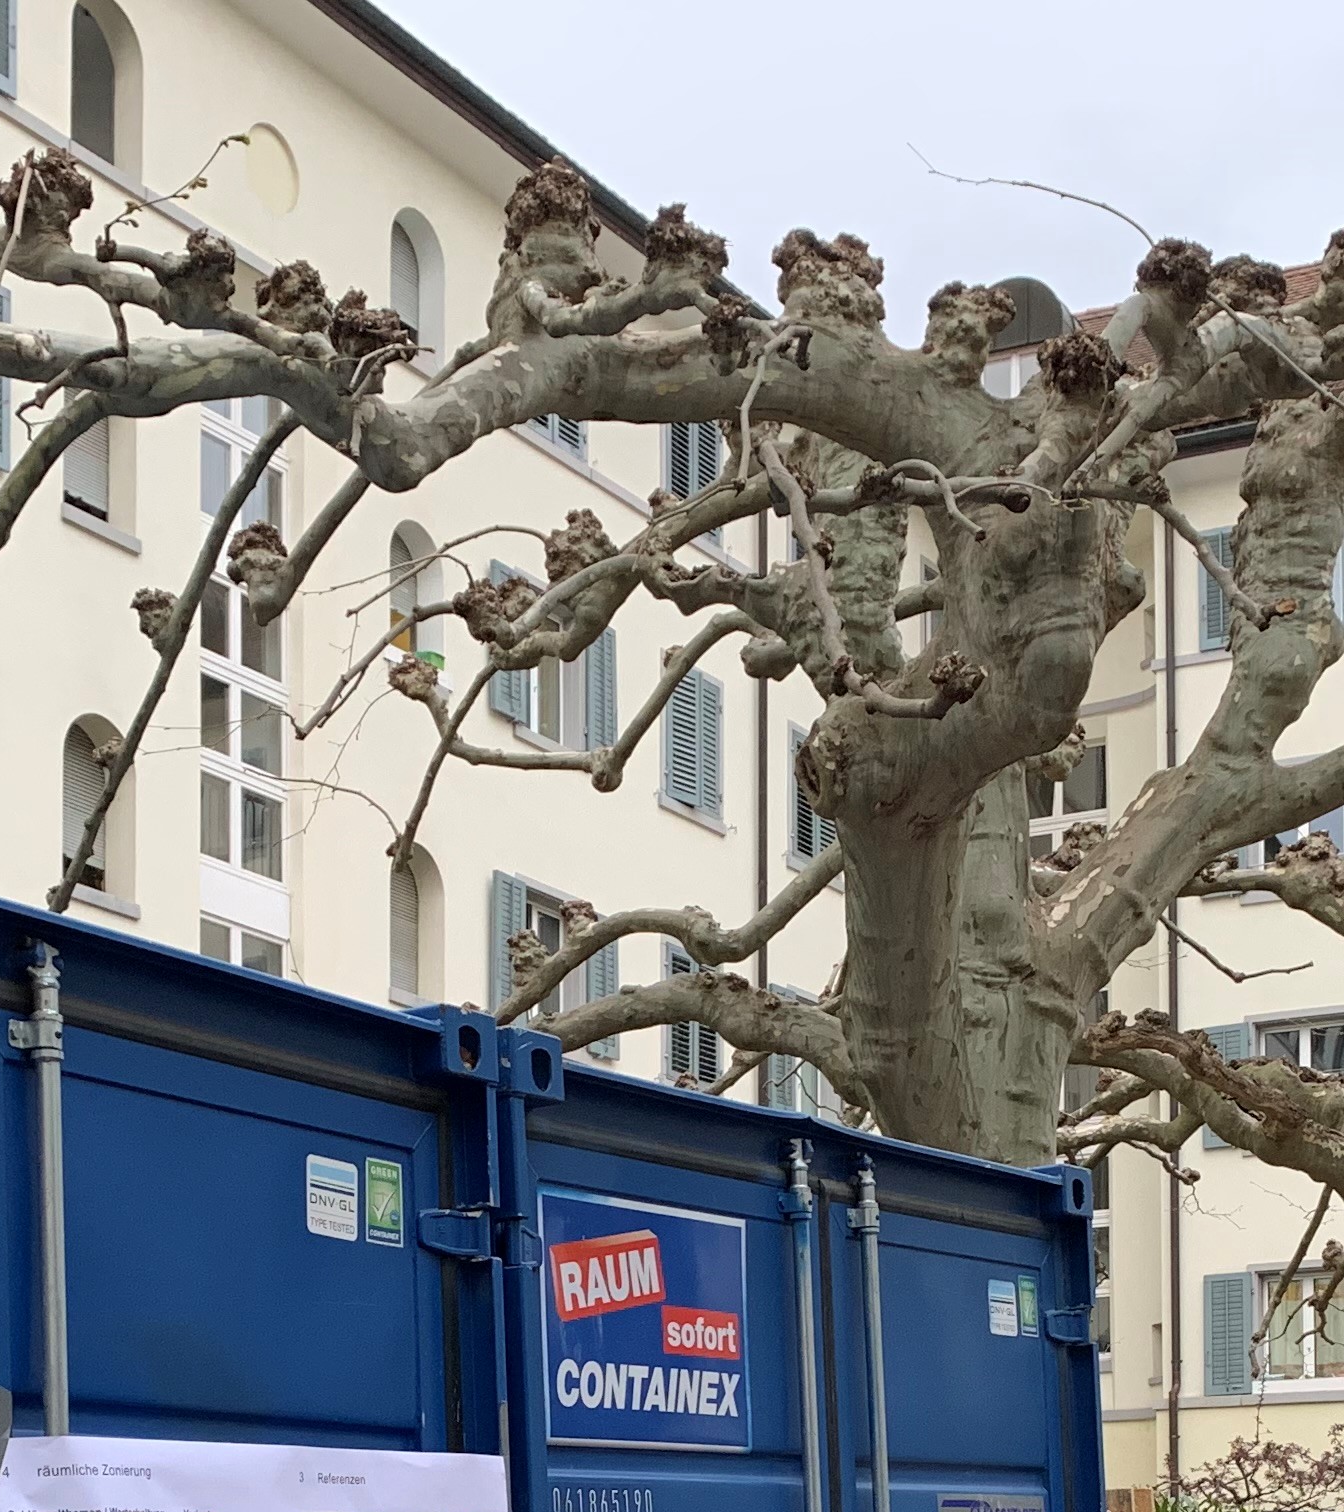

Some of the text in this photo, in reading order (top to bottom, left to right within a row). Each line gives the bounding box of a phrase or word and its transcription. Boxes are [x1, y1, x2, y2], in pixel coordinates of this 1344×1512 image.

[370, 1164, 398, 1179] GREEN
[310, 1216, 355, 1235] TYPE TESTED
[560, 1246, 660, 1312] RAUM
[667, 1316, 737, 1353] sofort
[557, 1358, 740, 1418] CONTAINEX
[3, 1464, 152, 1480] 4 räumliche Zonierung
[299, 1471, 366, 1485] 3 Referenzen
